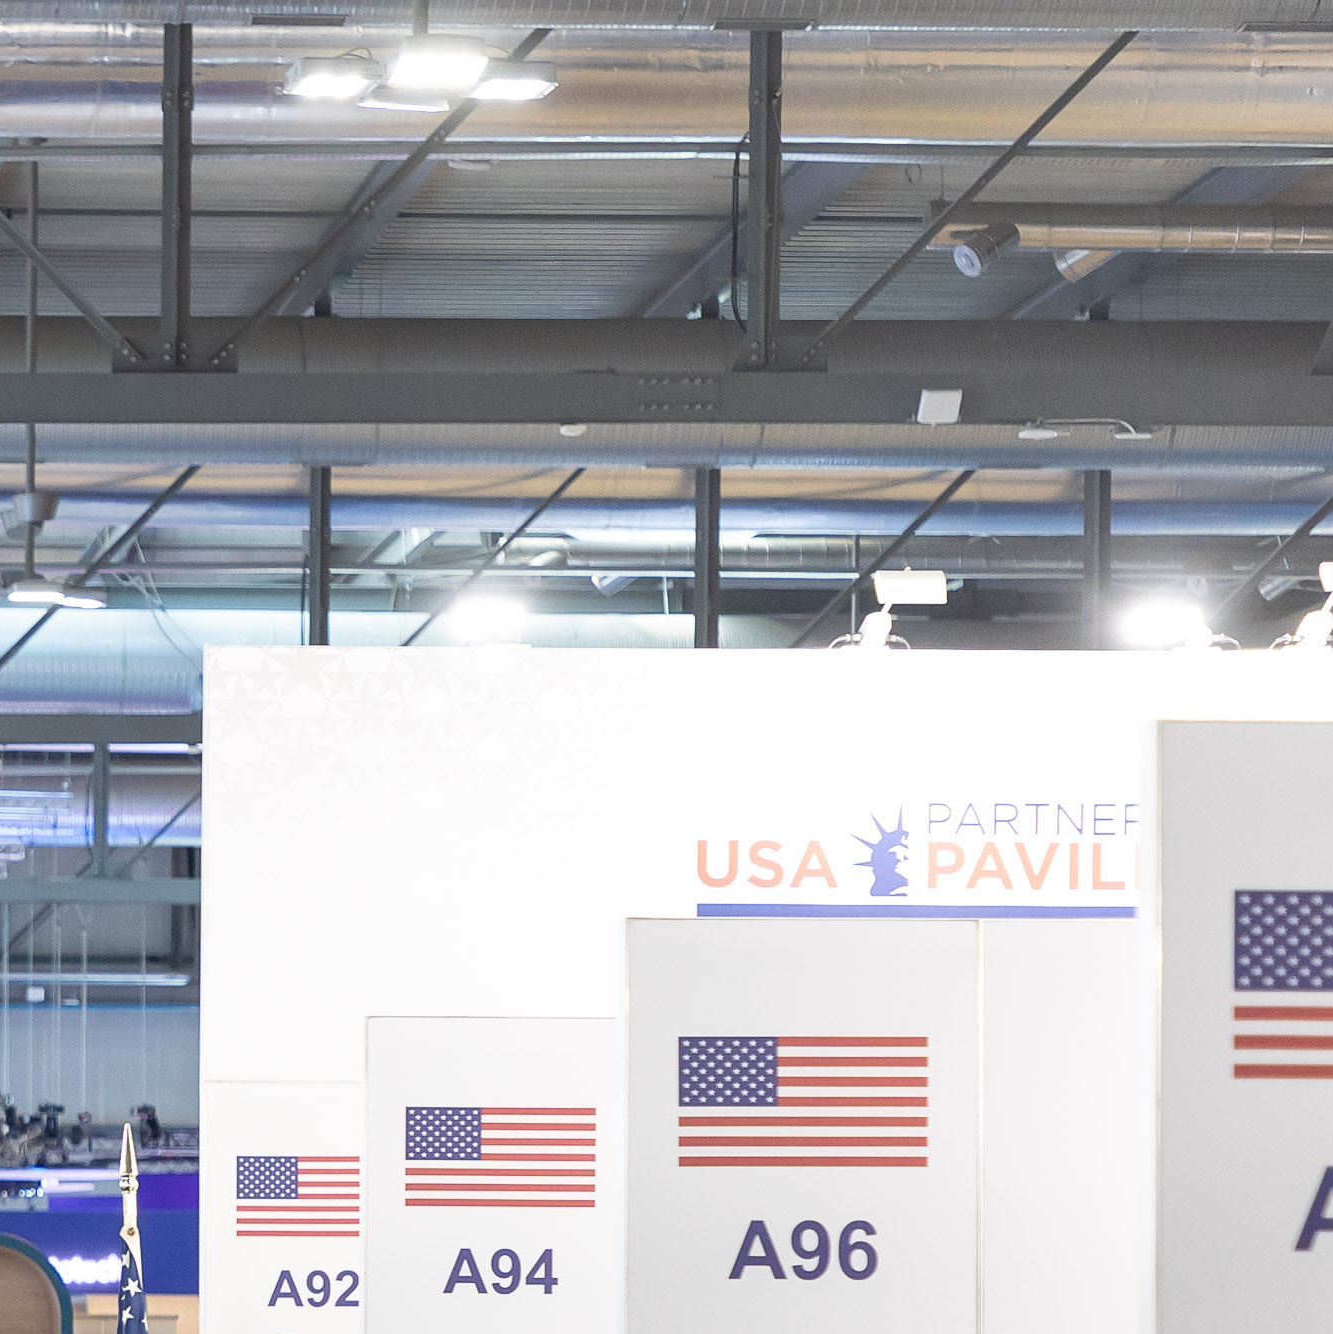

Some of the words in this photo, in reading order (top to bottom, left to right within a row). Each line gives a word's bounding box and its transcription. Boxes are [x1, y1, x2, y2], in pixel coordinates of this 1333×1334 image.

[696, 839, 840, 889] USA
[443, 1248, 559, 1294] A94
[728, 1219, 879, 1281] A96
[267, 1270, 360, 1307] A92
